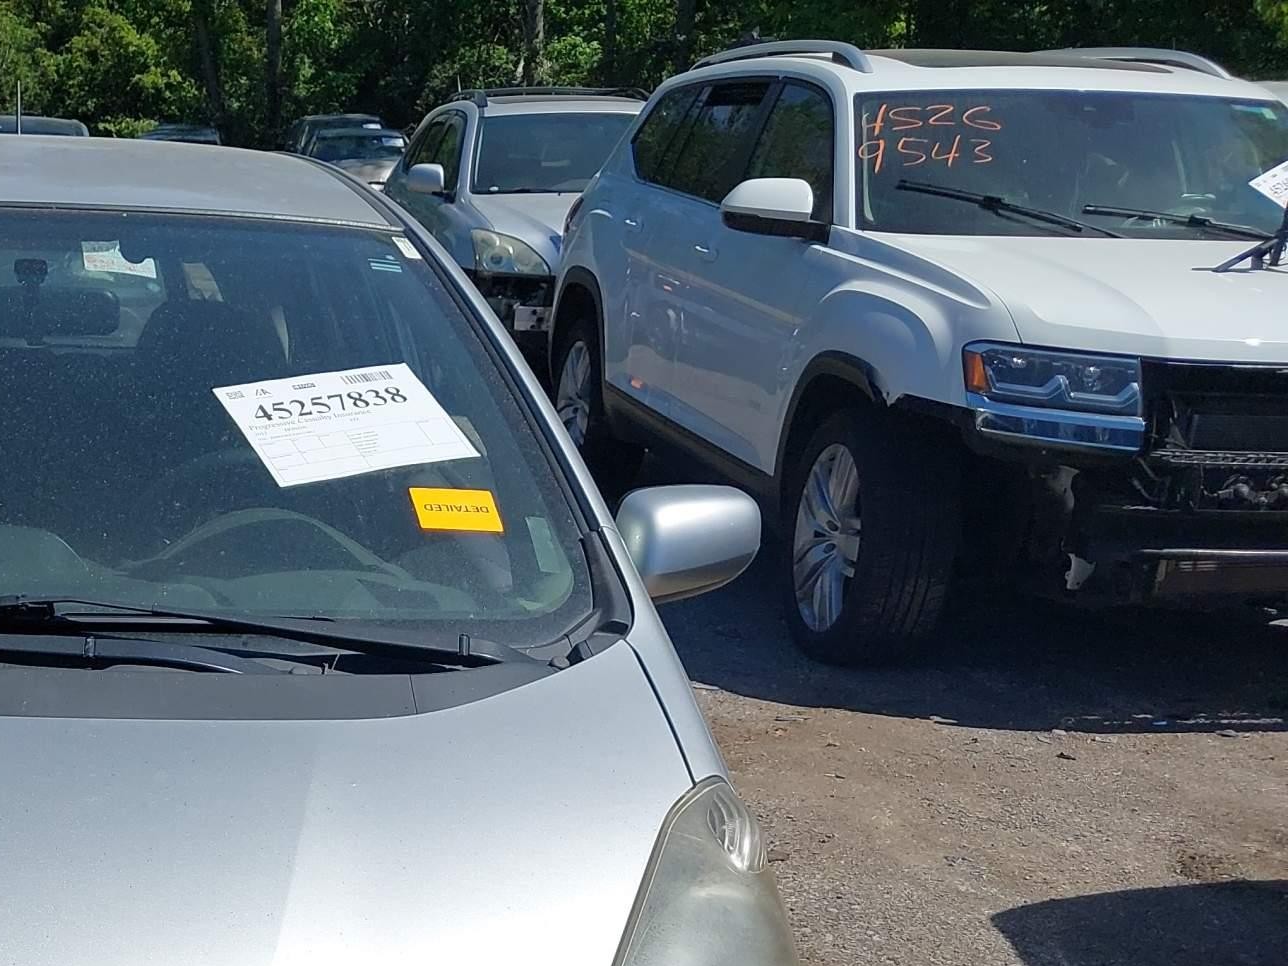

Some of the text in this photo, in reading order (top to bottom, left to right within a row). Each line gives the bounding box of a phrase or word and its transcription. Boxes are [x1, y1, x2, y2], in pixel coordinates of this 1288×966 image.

[861, 103, 1002, 137] 4526
[858, 134, 993, 174] 9543
[248, 420, 296, 431] Progressive
[297, 414, 334, 425] Casualty
[333, 410, 372, 419] Insurance
[253, 385, 408, 422] 45257838
[423, 502, 490, 514] DETAILED
